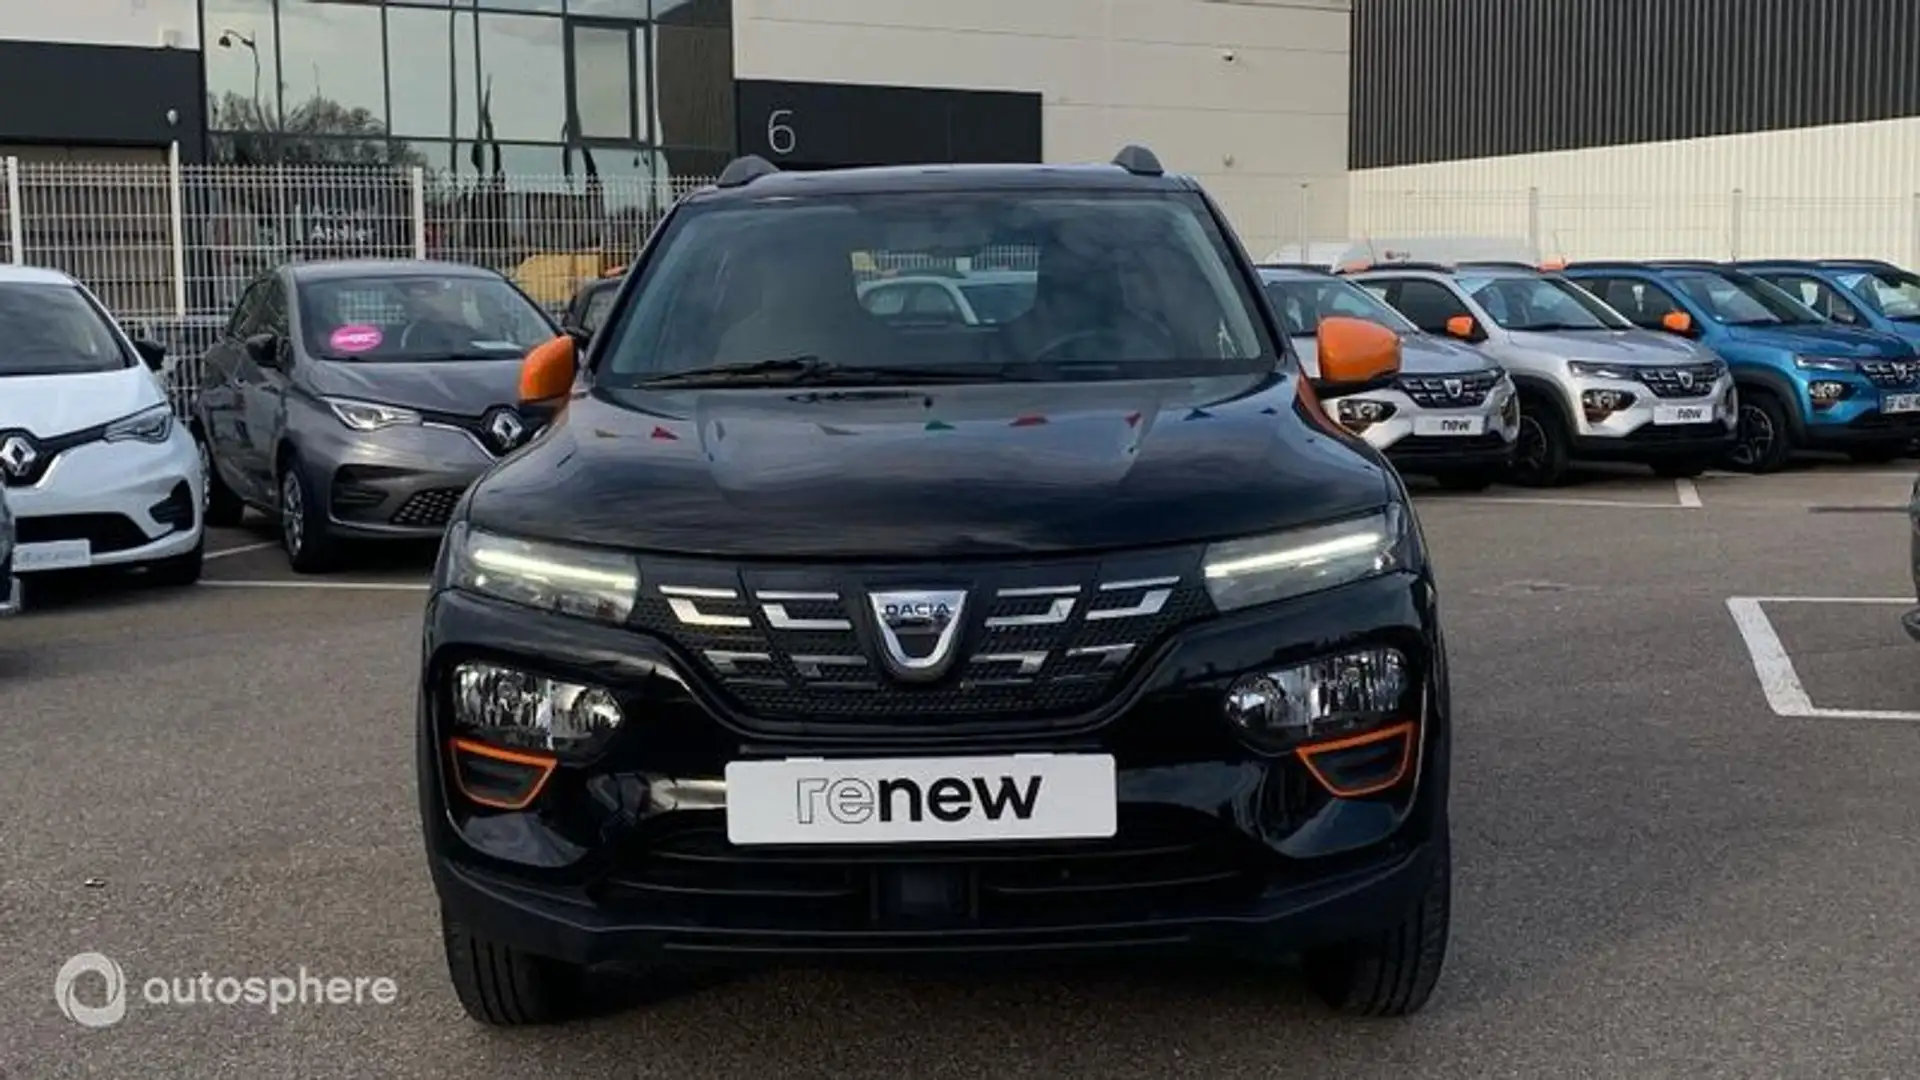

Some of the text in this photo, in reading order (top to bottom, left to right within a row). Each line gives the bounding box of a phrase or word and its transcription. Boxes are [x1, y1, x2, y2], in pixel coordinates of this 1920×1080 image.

[768, 110, 796, 154] 6
[885, 602, 950, 616] DACIA
[796, 775, 1042, 824] renew
